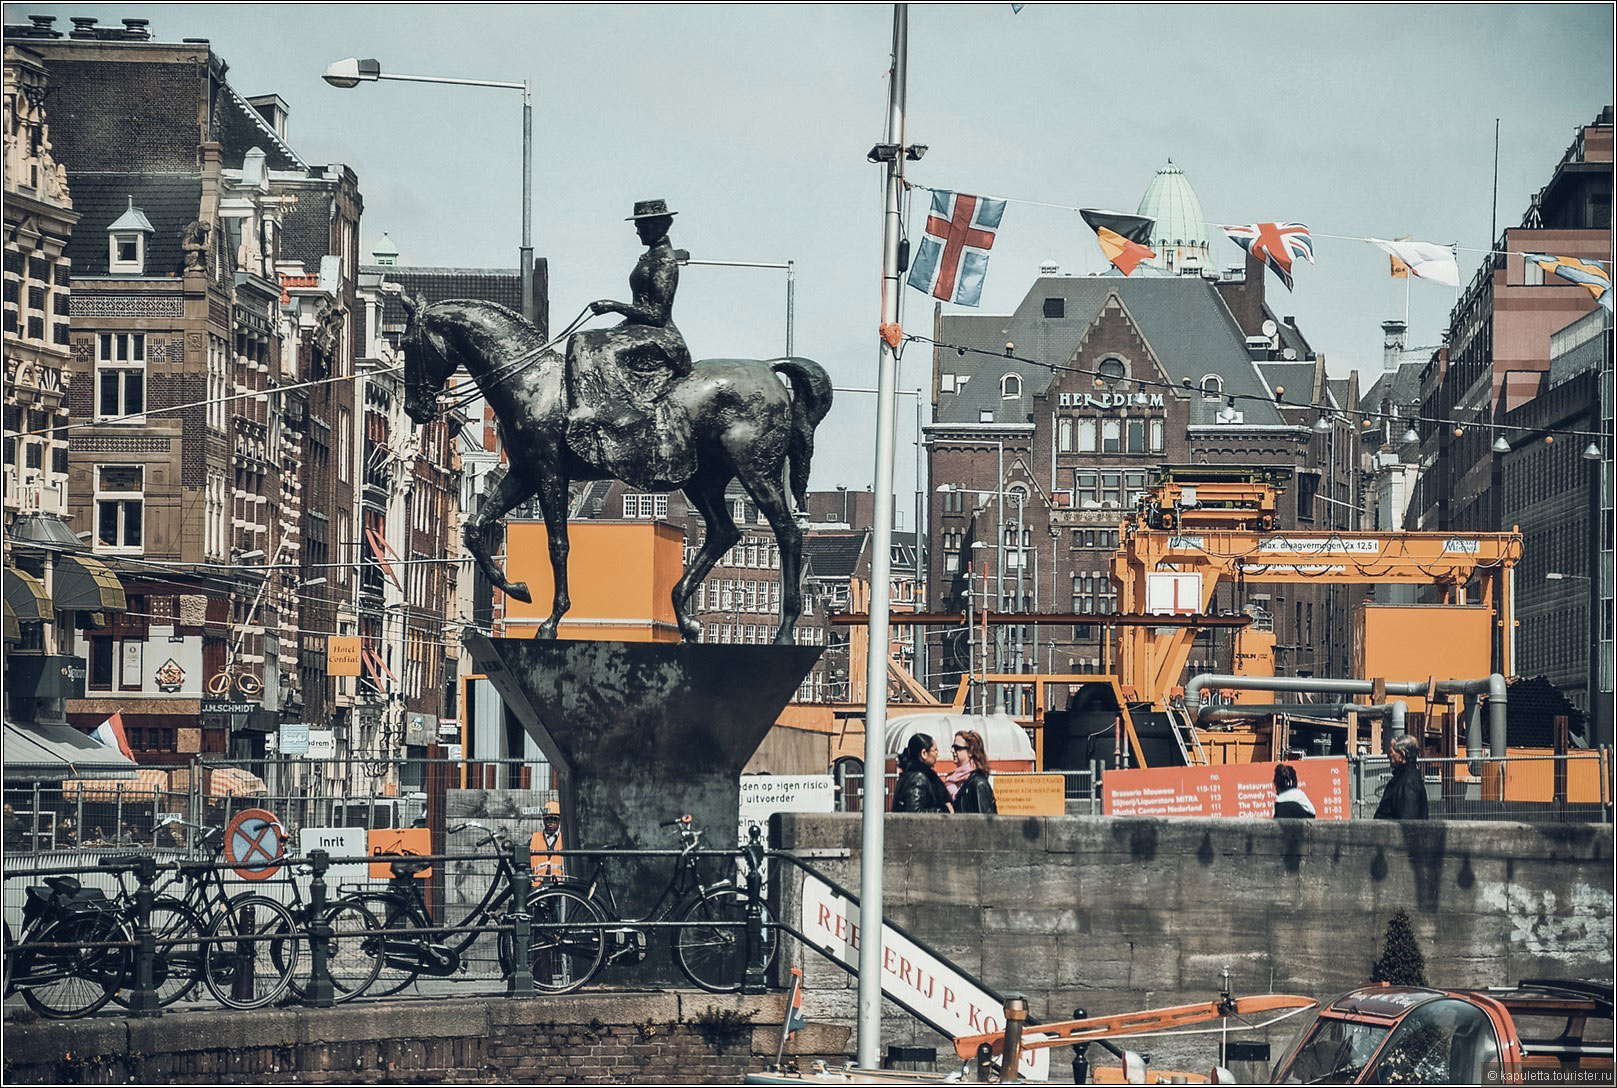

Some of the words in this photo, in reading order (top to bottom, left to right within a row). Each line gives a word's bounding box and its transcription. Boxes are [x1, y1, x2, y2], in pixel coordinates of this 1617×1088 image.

[1059, 392, 1164, 409] HEREDIM
[1345, 541, 1355, 550] 2x
[1357, 541, 1373, 551] 12,5
[761, 783, 773, 793] op
[802, 781, 829, 790] risico
[746, 794, 795, 803] uitvoerder
[1237, 792, 1265, 800] Comedy
[1167, 804, 1202, 813] Nederland
[1238, 801, 1250, 809] The
[320, 836, 344, 847] Inrit
[818, 902, 934, 998] REEERIJ
[942, 985, 960, 1019] P.
